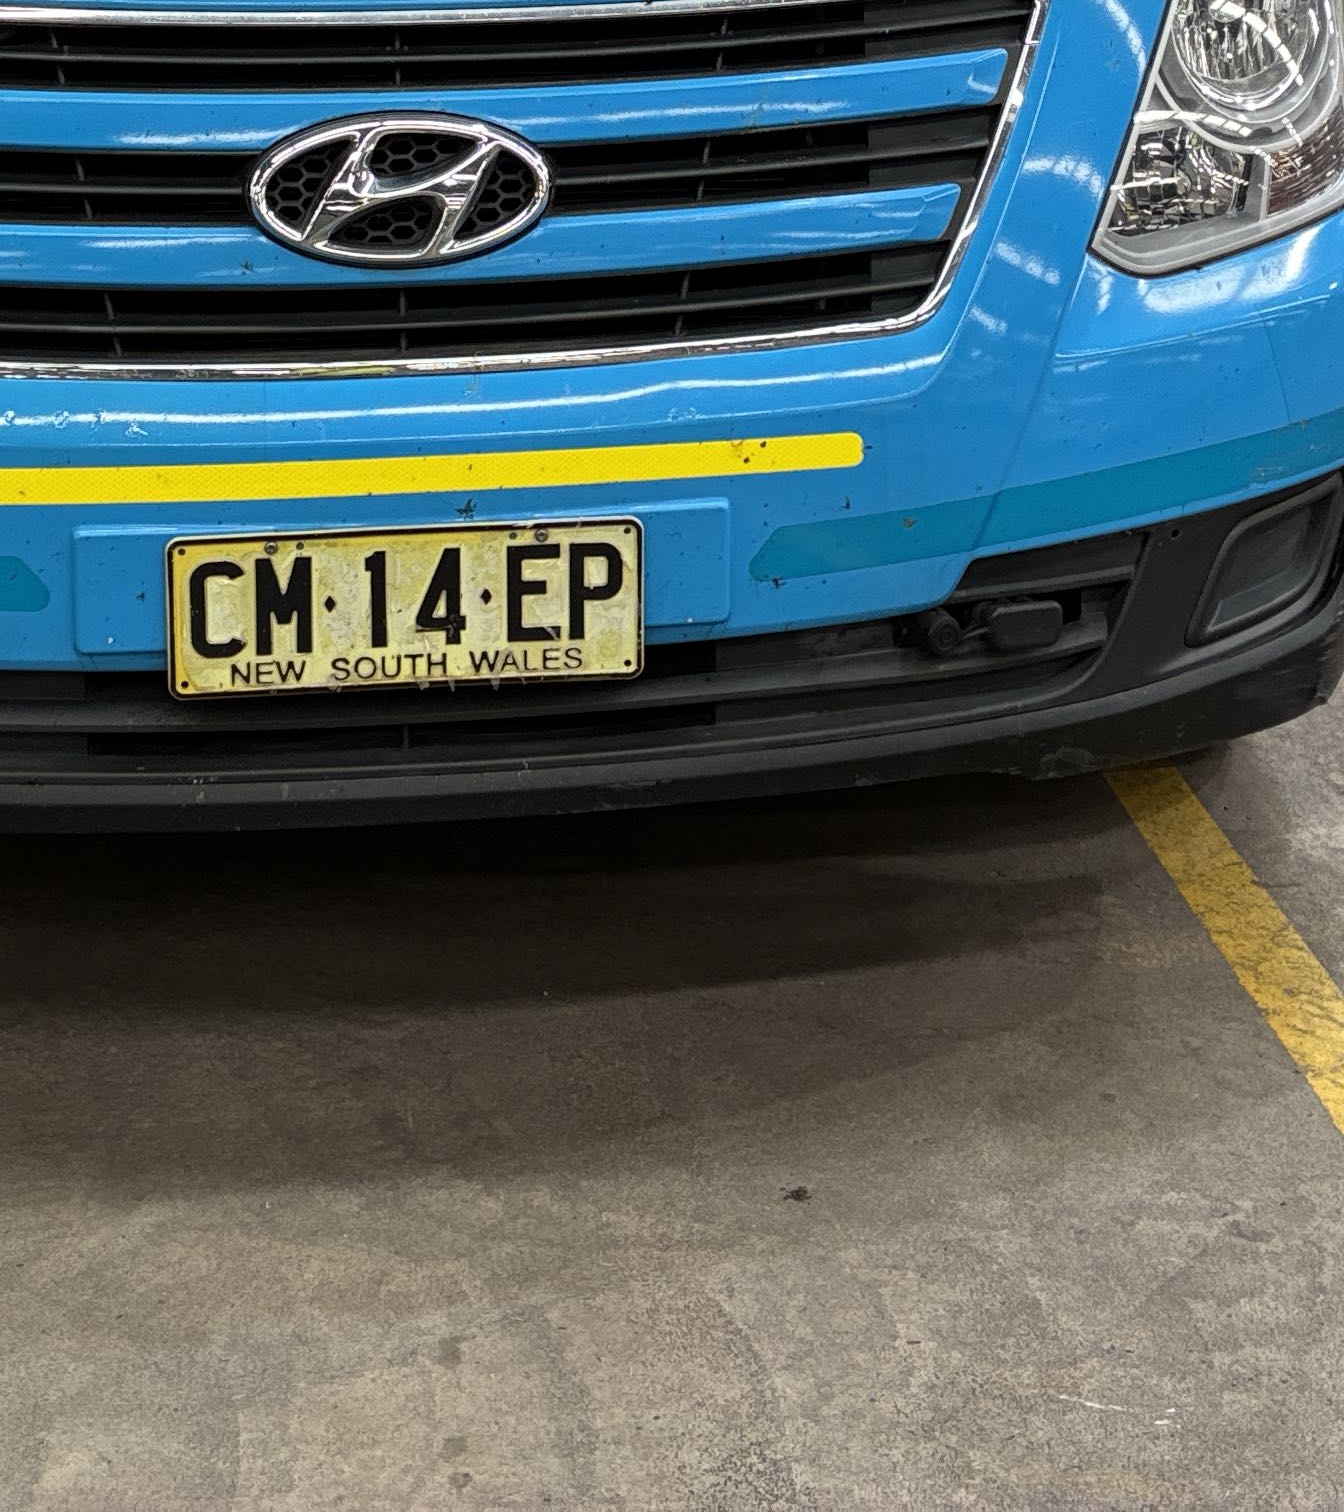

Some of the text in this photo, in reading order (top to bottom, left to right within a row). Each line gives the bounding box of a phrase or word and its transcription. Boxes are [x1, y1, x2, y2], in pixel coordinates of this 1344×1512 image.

[230, 646, 583, 687] NEW SOUTH WALES
